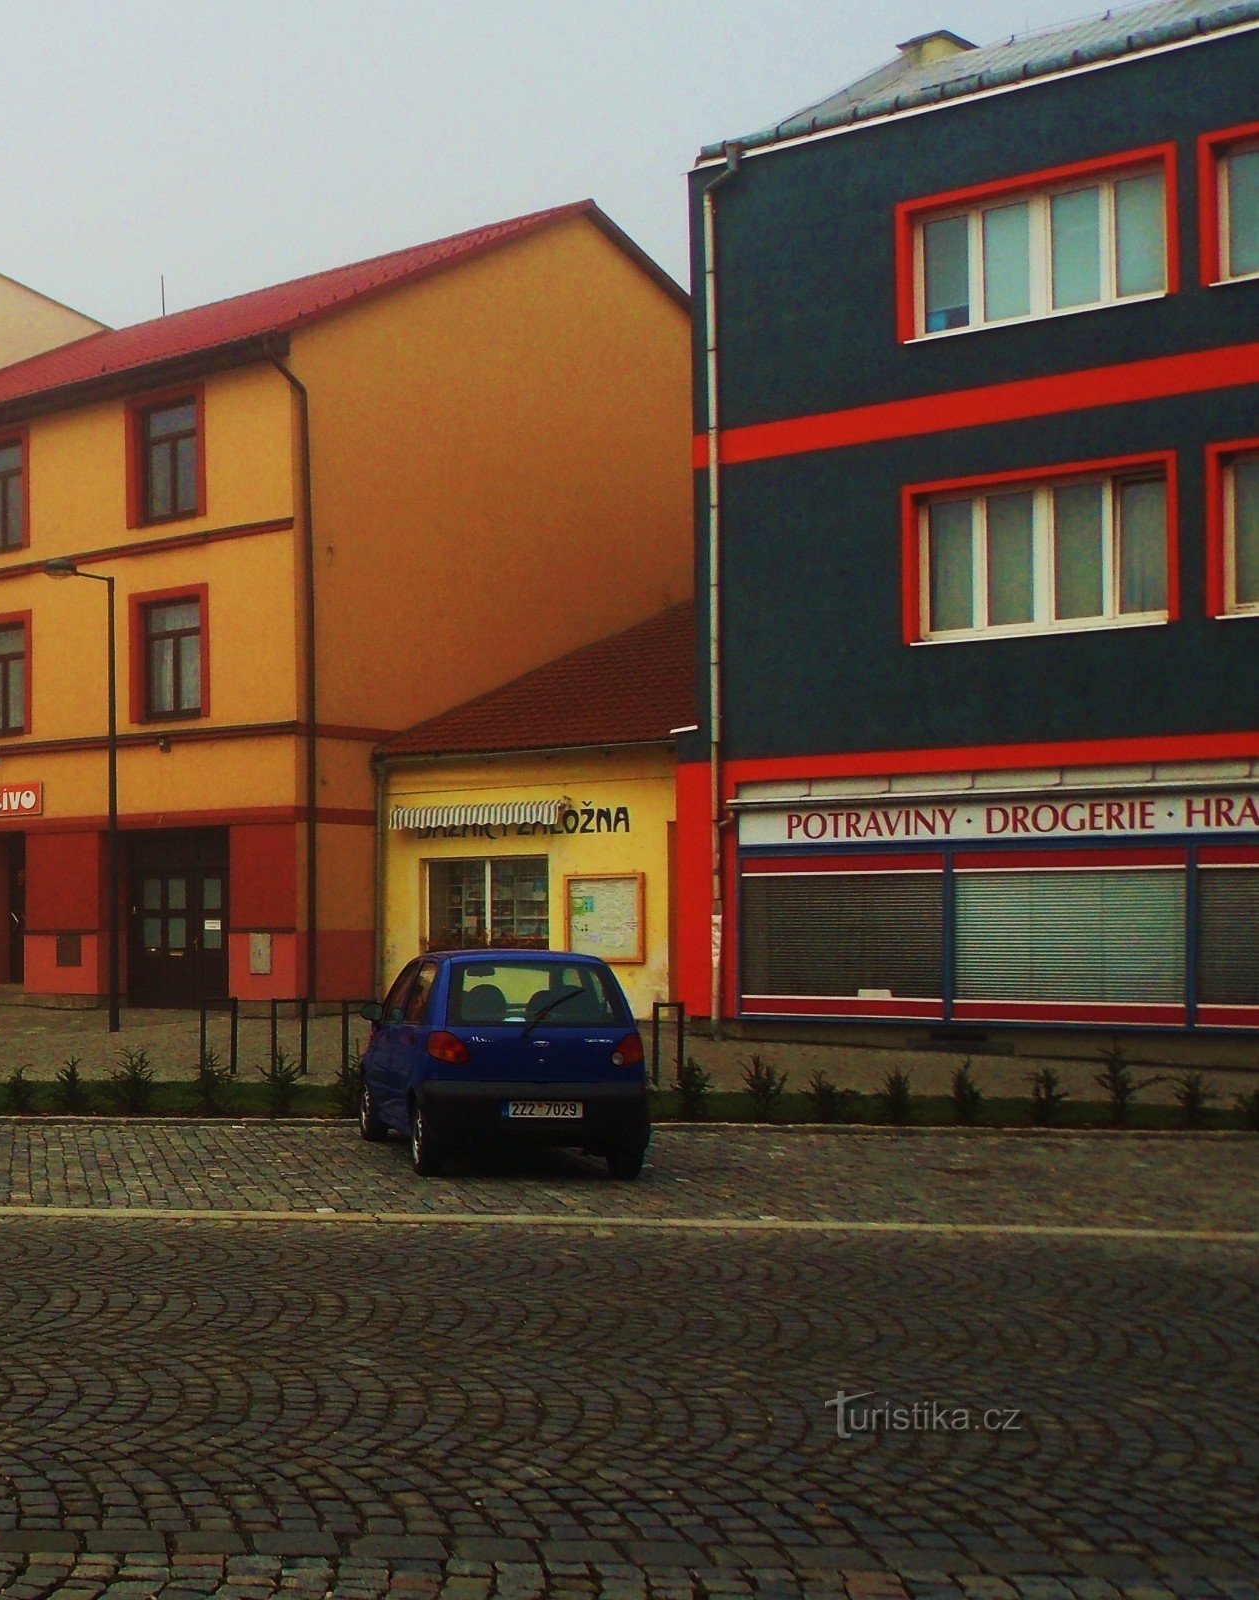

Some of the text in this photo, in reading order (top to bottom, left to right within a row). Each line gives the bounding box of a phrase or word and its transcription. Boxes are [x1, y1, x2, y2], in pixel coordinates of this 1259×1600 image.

[787, 796, 1259, 839] POTRAVINY DROGERIE HRA
[511, 1103, 577, 1116] 2Z2 7029
